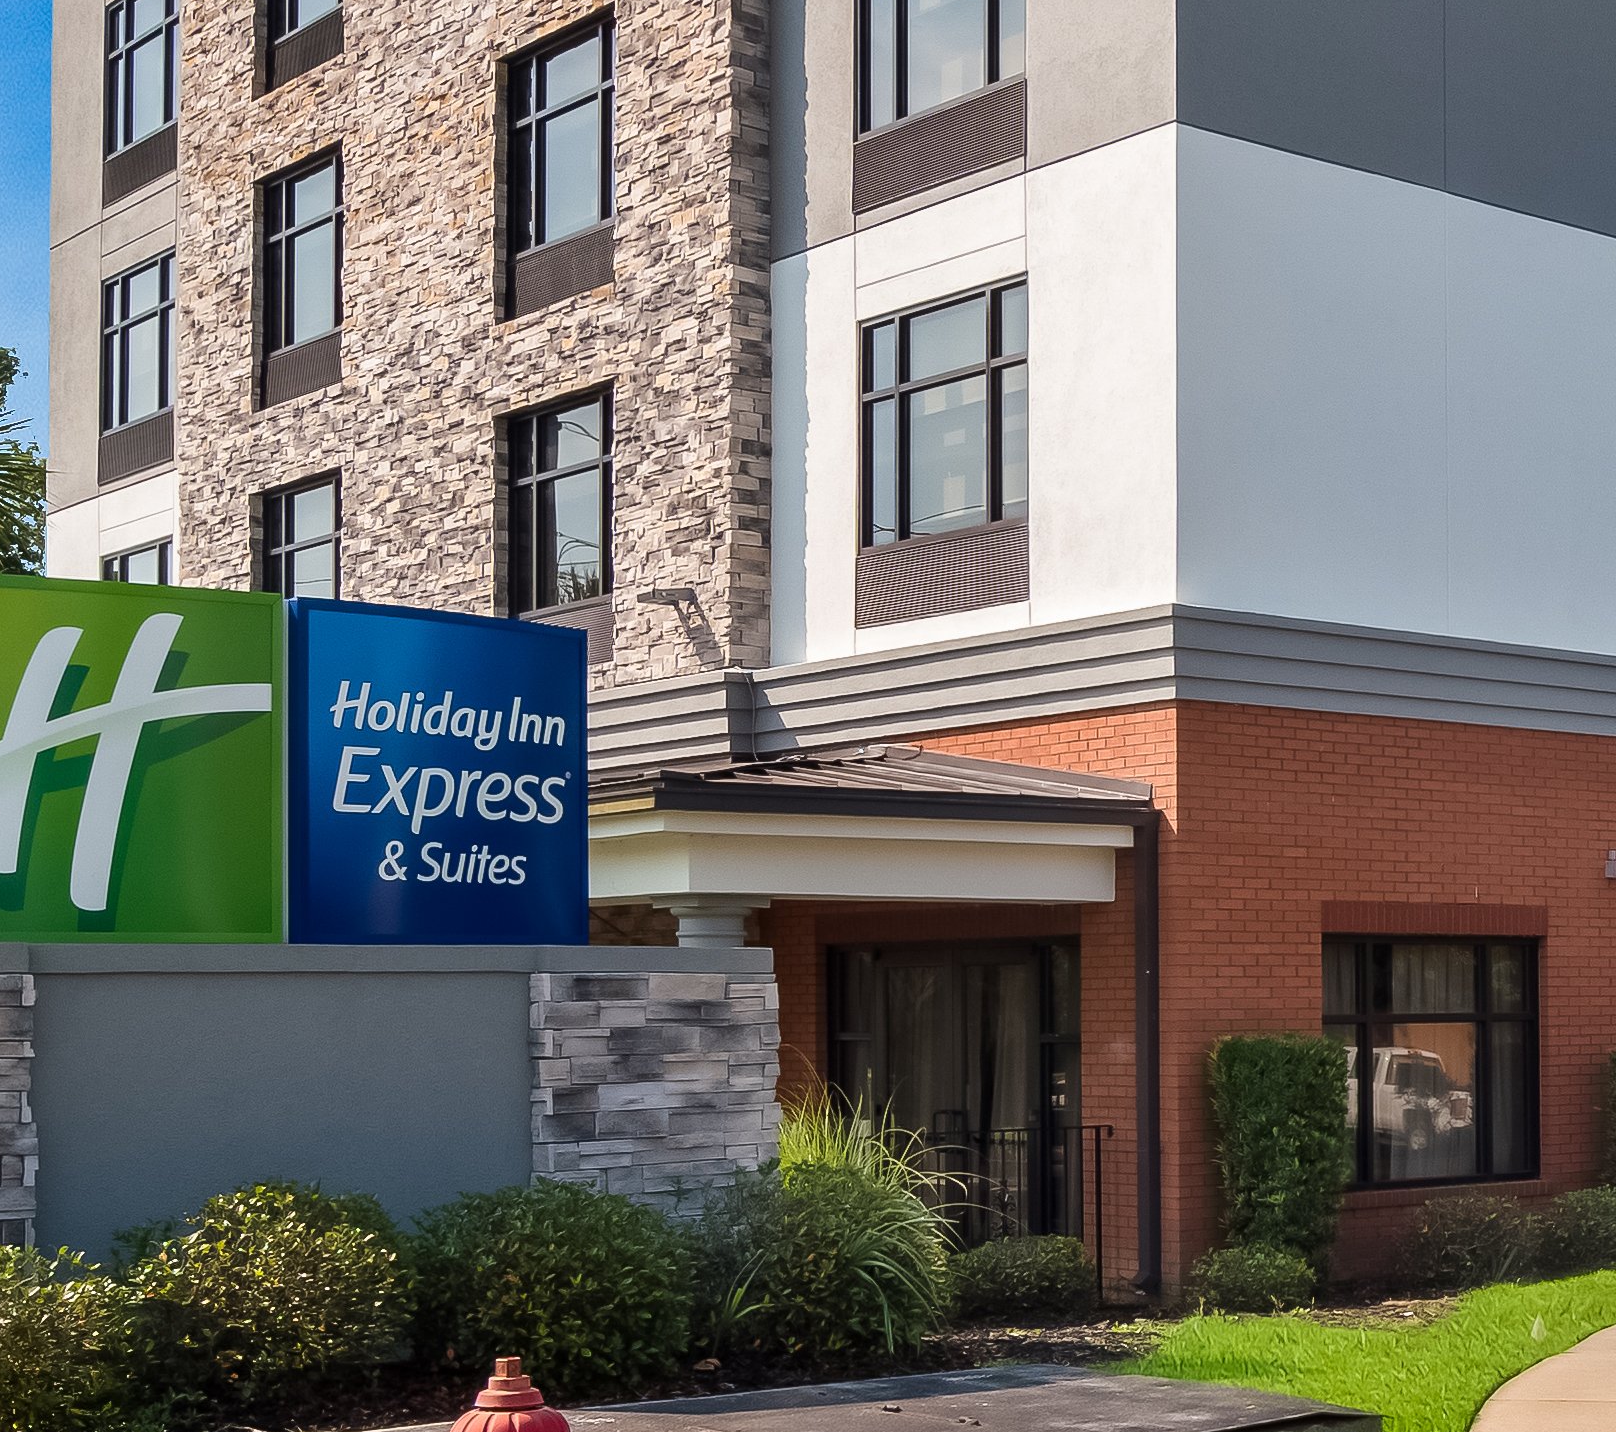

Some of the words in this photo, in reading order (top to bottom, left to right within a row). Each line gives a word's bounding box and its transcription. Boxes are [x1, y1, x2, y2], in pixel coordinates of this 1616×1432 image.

[330, 680, 502, 751] Holiday
[508, 697, 565, 746] Inn
[333, 745, 566, 834] Express
[378, 840, 408, 881] &
[417, 842, 527, 885] Suites
